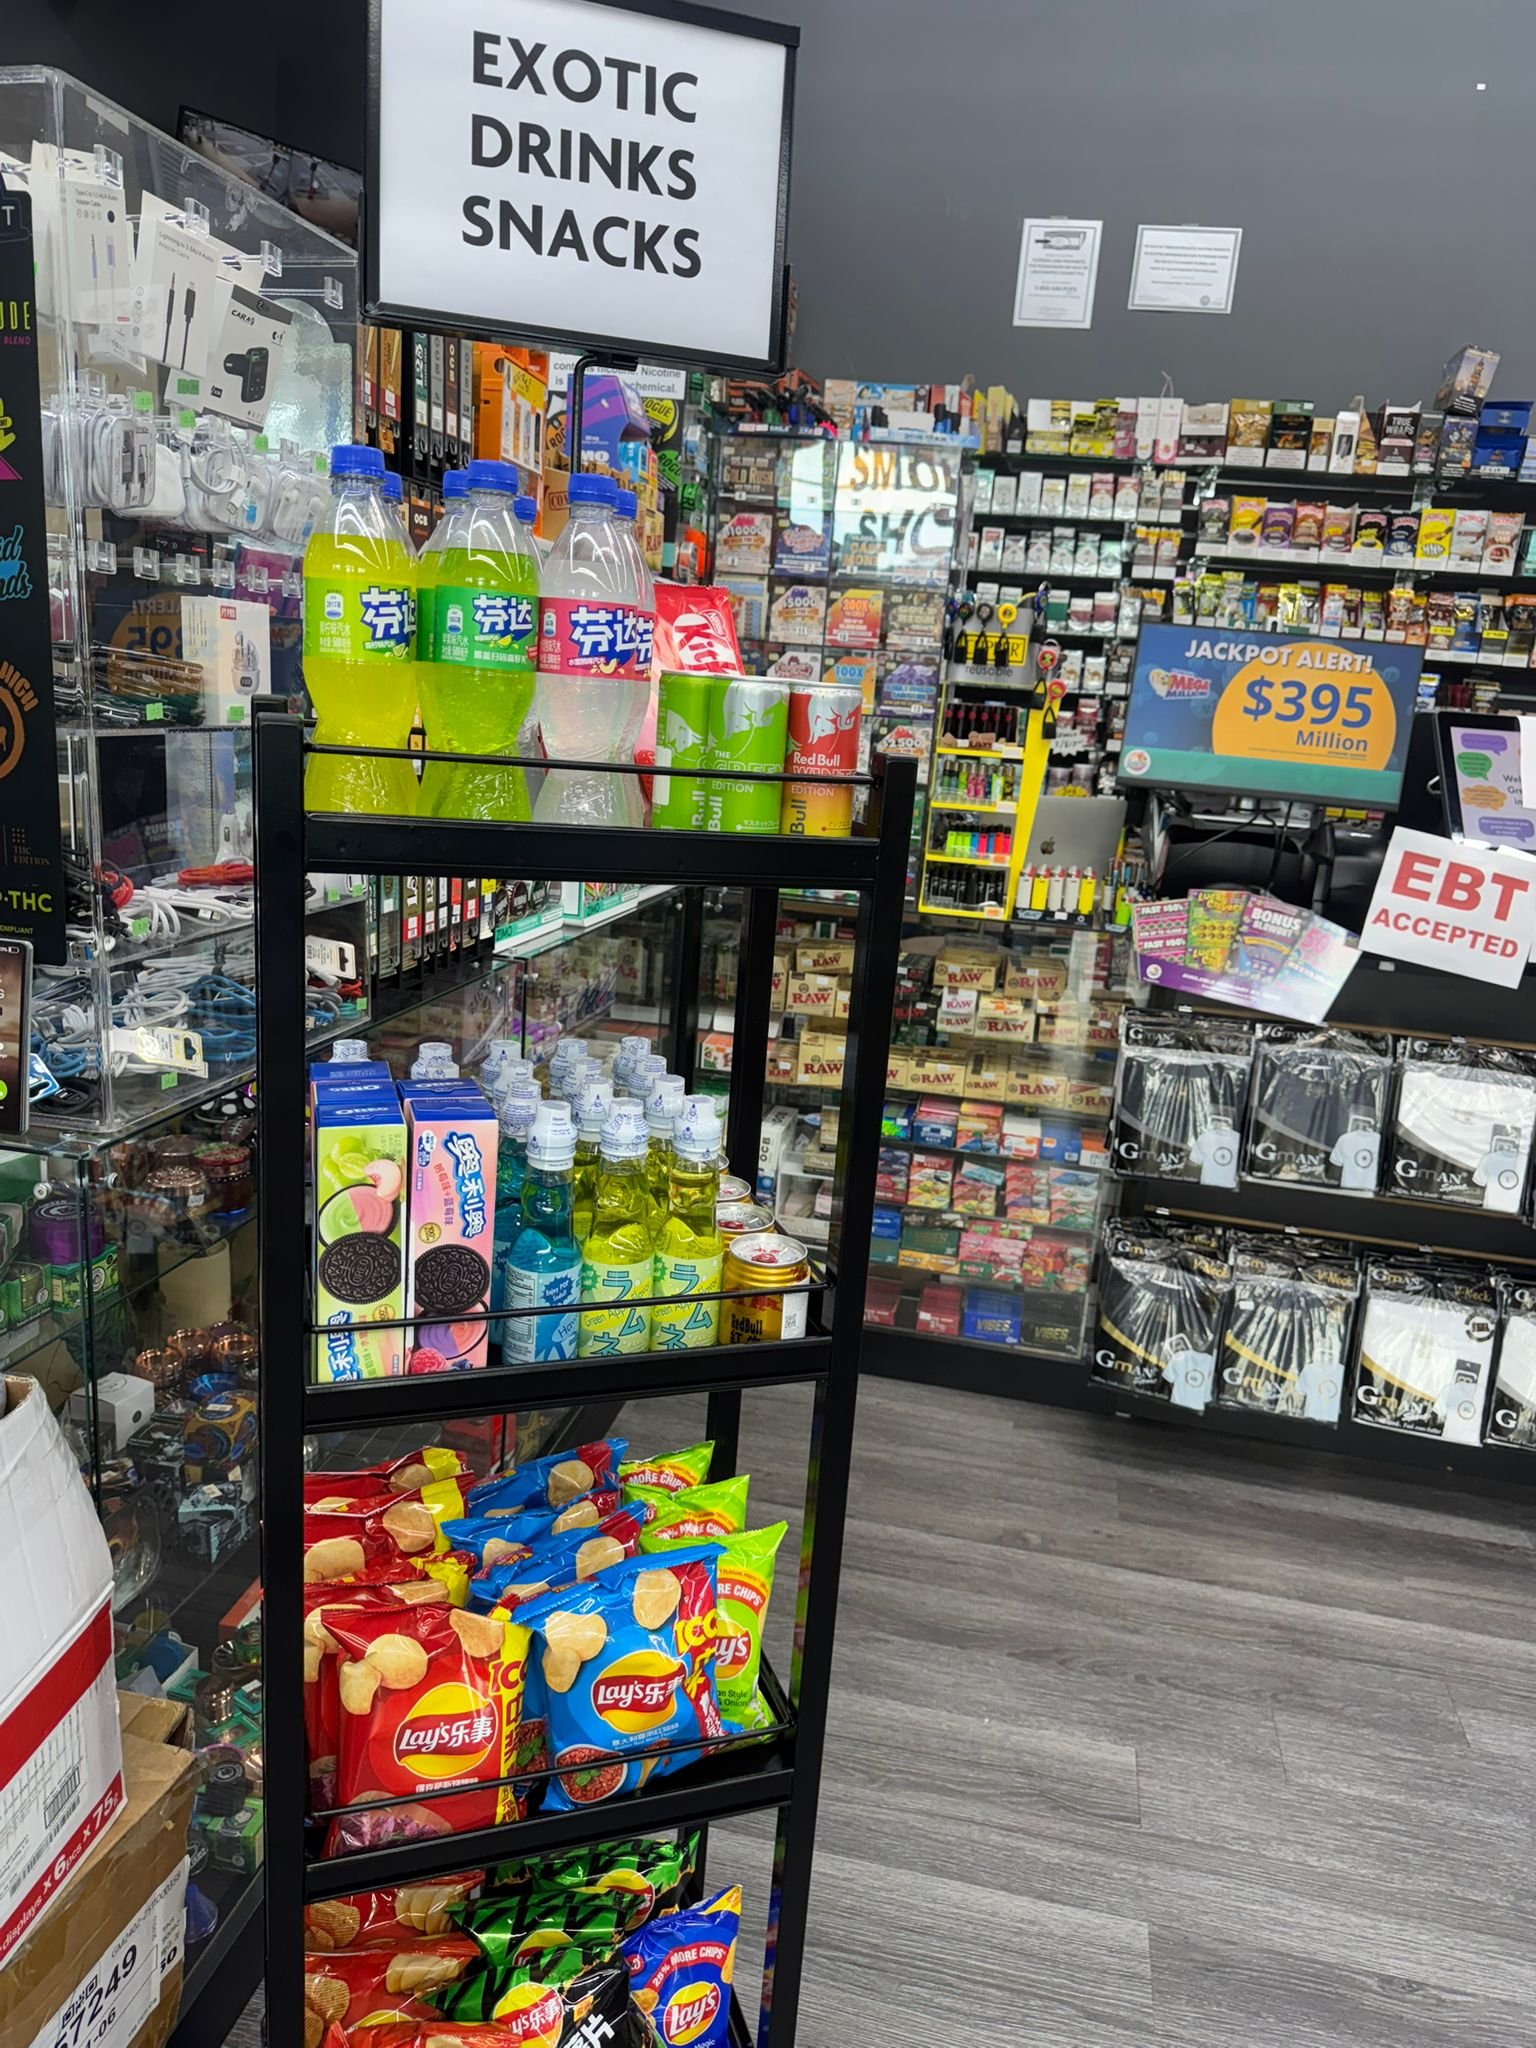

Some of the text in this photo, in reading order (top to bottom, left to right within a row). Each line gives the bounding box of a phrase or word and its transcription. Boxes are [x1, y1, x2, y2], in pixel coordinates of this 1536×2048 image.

[473, 30, 698, 123] EXOTIC
[471, 113, 697, 201] DRINKS
[462, 194, 701, 279] SNACKS
[4, 335, 31, 345] BLEND
[641, 366, 681, 378] Nicotine
[555, 376, 564, 385] is
[1391, 416, 1413, 428] TRUE
[1386, 425, 1415, 435] WRAPS
[473, 593, 533, 633] 芬达
[842, 599, 869, 612] 200X
[570, 606, 638, 656] 芬达
[1185, 639, 1374, 674] JACKPOT ALERT!
[835, 666, 864, 678] 100X
[1169, 674, 1209, 690] MEGA
[1242, 675, 1373, 729] $395
[1295, 729, 1368, 753] Million
[714, 750, 731, 759] THE
[793, 751, 840, 766] Red Bull
[711, 781, 754, 793] EDITION
[791, 785, 835, 797] EDITION
[708, 796, 723, 832] Bull
[789, 799, 807, 835] Bull
[1391, 850, 1530, 922] EBT
[1251, 907, 1302, 931] BONUS
[496, 926, 513, 940] ZIMO
[1371, 907, 1519, 959] ACCEPTED
[813, 955, 842, 967] RAW
[947, 972, 983, 983] RAW
[1019, 976, 1059, 989] RAW
[792, 991, 832, 1005] RAW
[946, 1000, 973, 1009] RAW
[945, 1018, 971, 1026] RAW
[987, 1020, 1029, 1034] RAW
[803, 1063, 843, 1075] RAW
[921, 1073, 956, 1083] RAW
[973, 1081, 999, 1089] RAW
[1019, 1084, 1061, 1096] RAW
[335, 1105, 389, 1115] OREO
[760, 1136, 771, 1162] OCB
[446, 1134, 486, 1238] 奥利奥
[1317, 1269, 1355, 1287] V-Neck
[545, 1285, 560, 1297] Enjoy
[1454, 1284, 1491, 1301] V-Neck
[583, 1314, 607, 1328] Green
[976, 1318, 1012, 1333] VIBES
[1034, 1325, 1070, 1341] VIBES
[628, 1470, 688, 1491] MORE CHIPS
[680, 1521, 704, 1537] MORE
[718, 1582, 762, 1607] RE CHIPS
[597, 1680, 643, 1708] Lay's
[399, 1721, 450, 1752] Lay's
[447, 1715, 494, 1748] 乐事
[653, 1946, 723, 1987] 25% MORE CHIPS
[669, 1989, 717, 2037] Lay's
